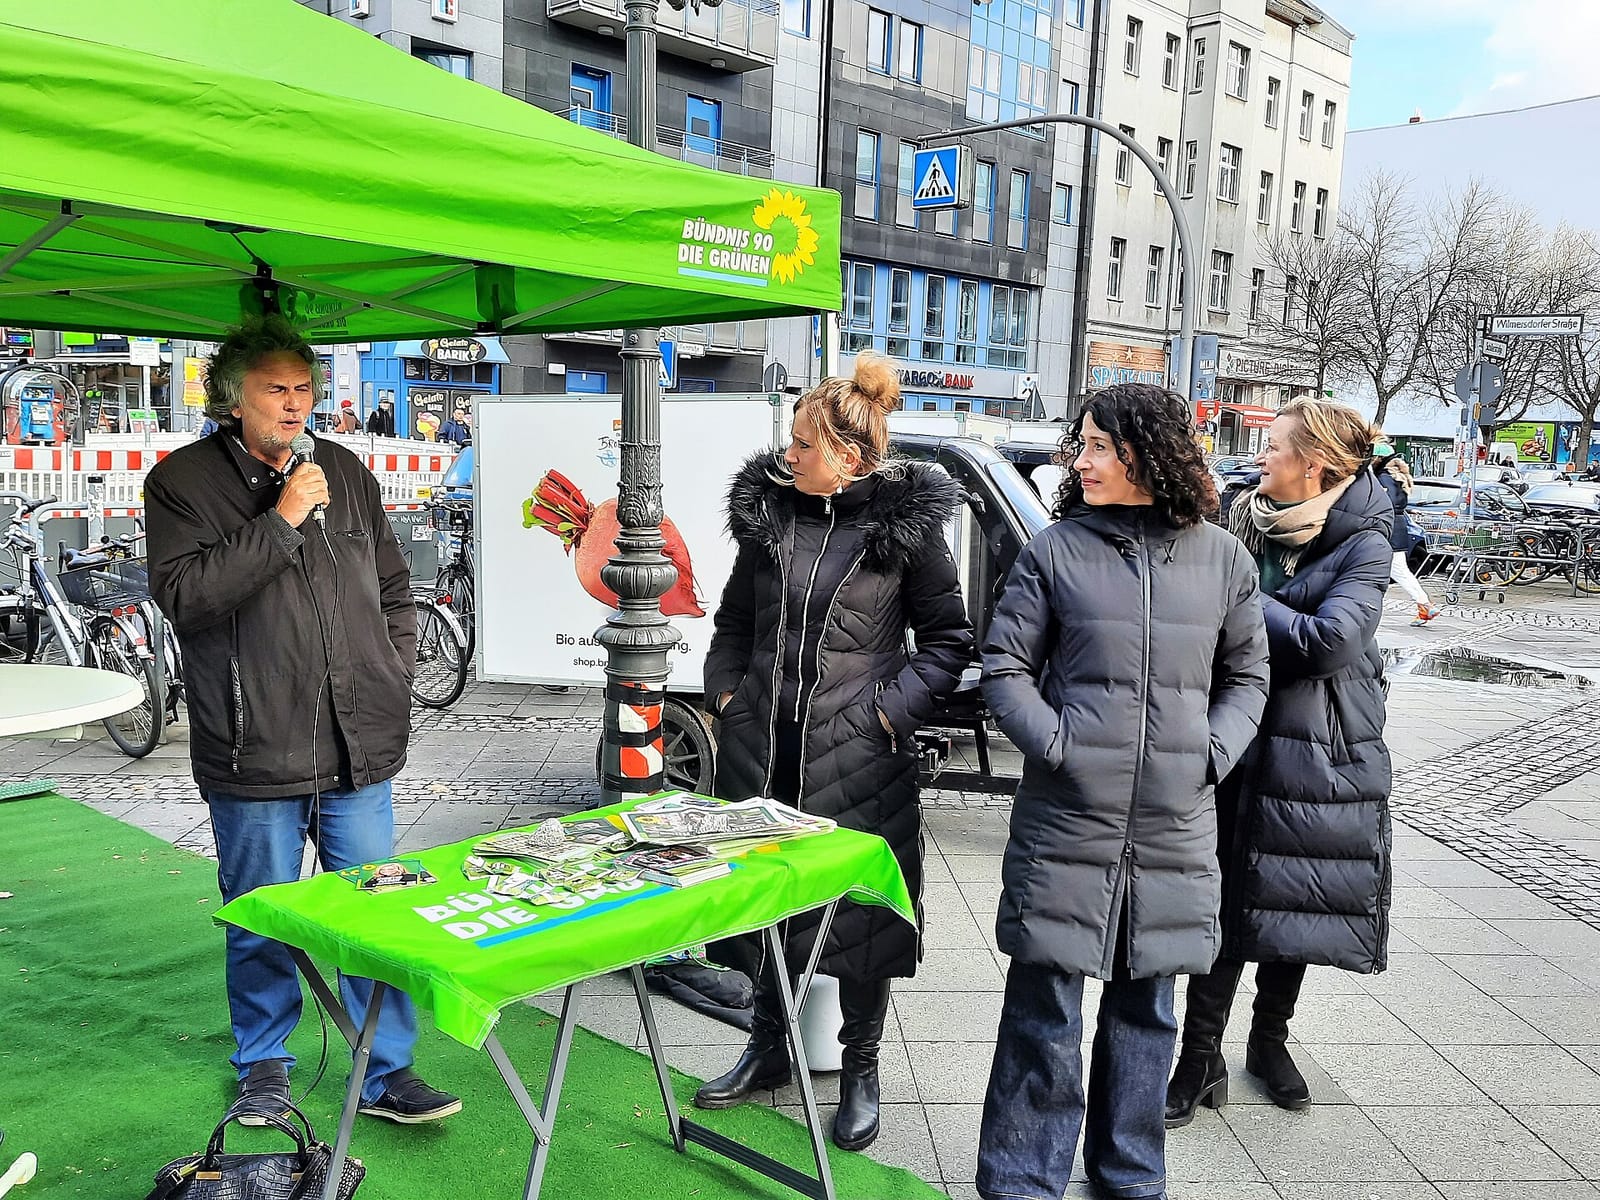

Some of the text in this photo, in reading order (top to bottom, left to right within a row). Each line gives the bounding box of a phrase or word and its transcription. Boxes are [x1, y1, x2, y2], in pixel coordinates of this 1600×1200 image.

[682, 217, 773, 252] BÜNDNIS 90
[678, 243, 770, 275] DIE GRÜNEN
[1496, 318, 1578, 330] Wilmersdorfer Straße
[440, 338, 468, 348] Gelato
[437, 348, 471, 362] BARIK
[1235, 358, 1271, 375] PICTURE
[944, 373, 974, 388] BANK
[413, 392, 444, 407] Gelato
[555, 633, 575, 645] Bio
[578, 636, 600, 647] aus
[441, 906, 539, 940] DIE
